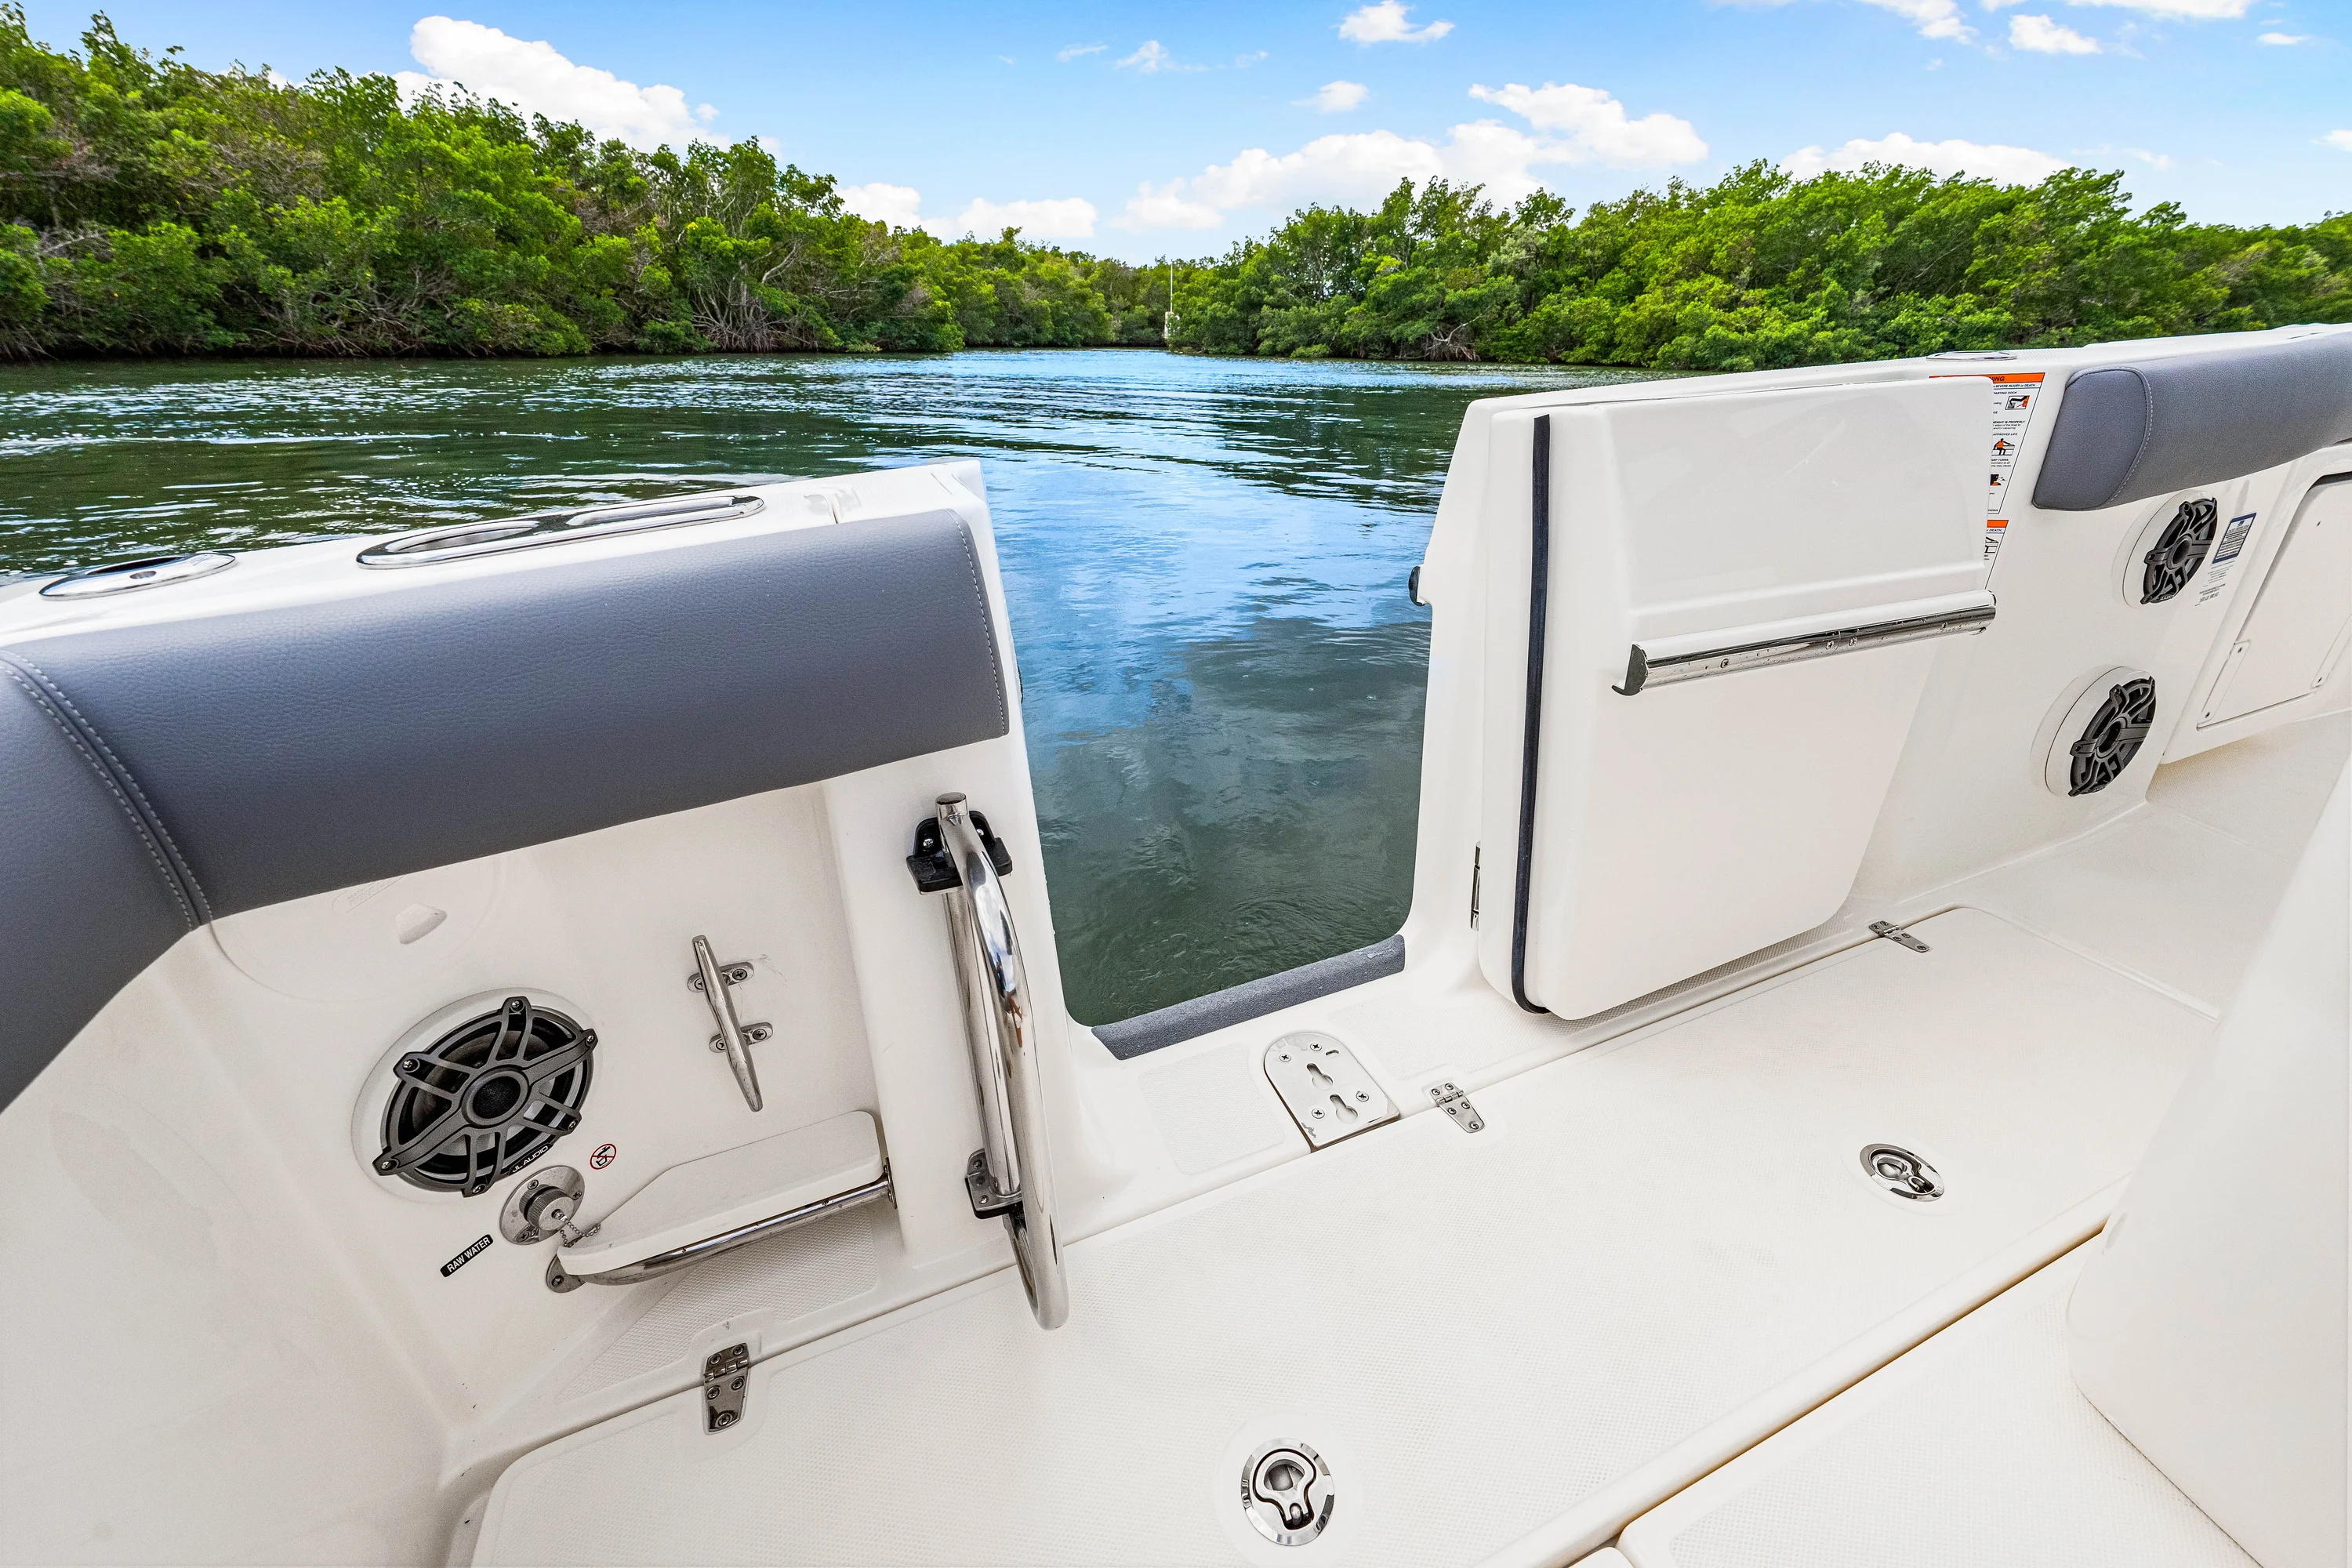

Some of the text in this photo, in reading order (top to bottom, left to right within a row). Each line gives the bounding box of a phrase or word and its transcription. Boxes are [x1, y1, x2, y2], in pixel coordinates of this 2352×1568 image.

[523, 1145, 549, 1166] AUDIO
[446, 1236, 491, 1272] RAW WATER
